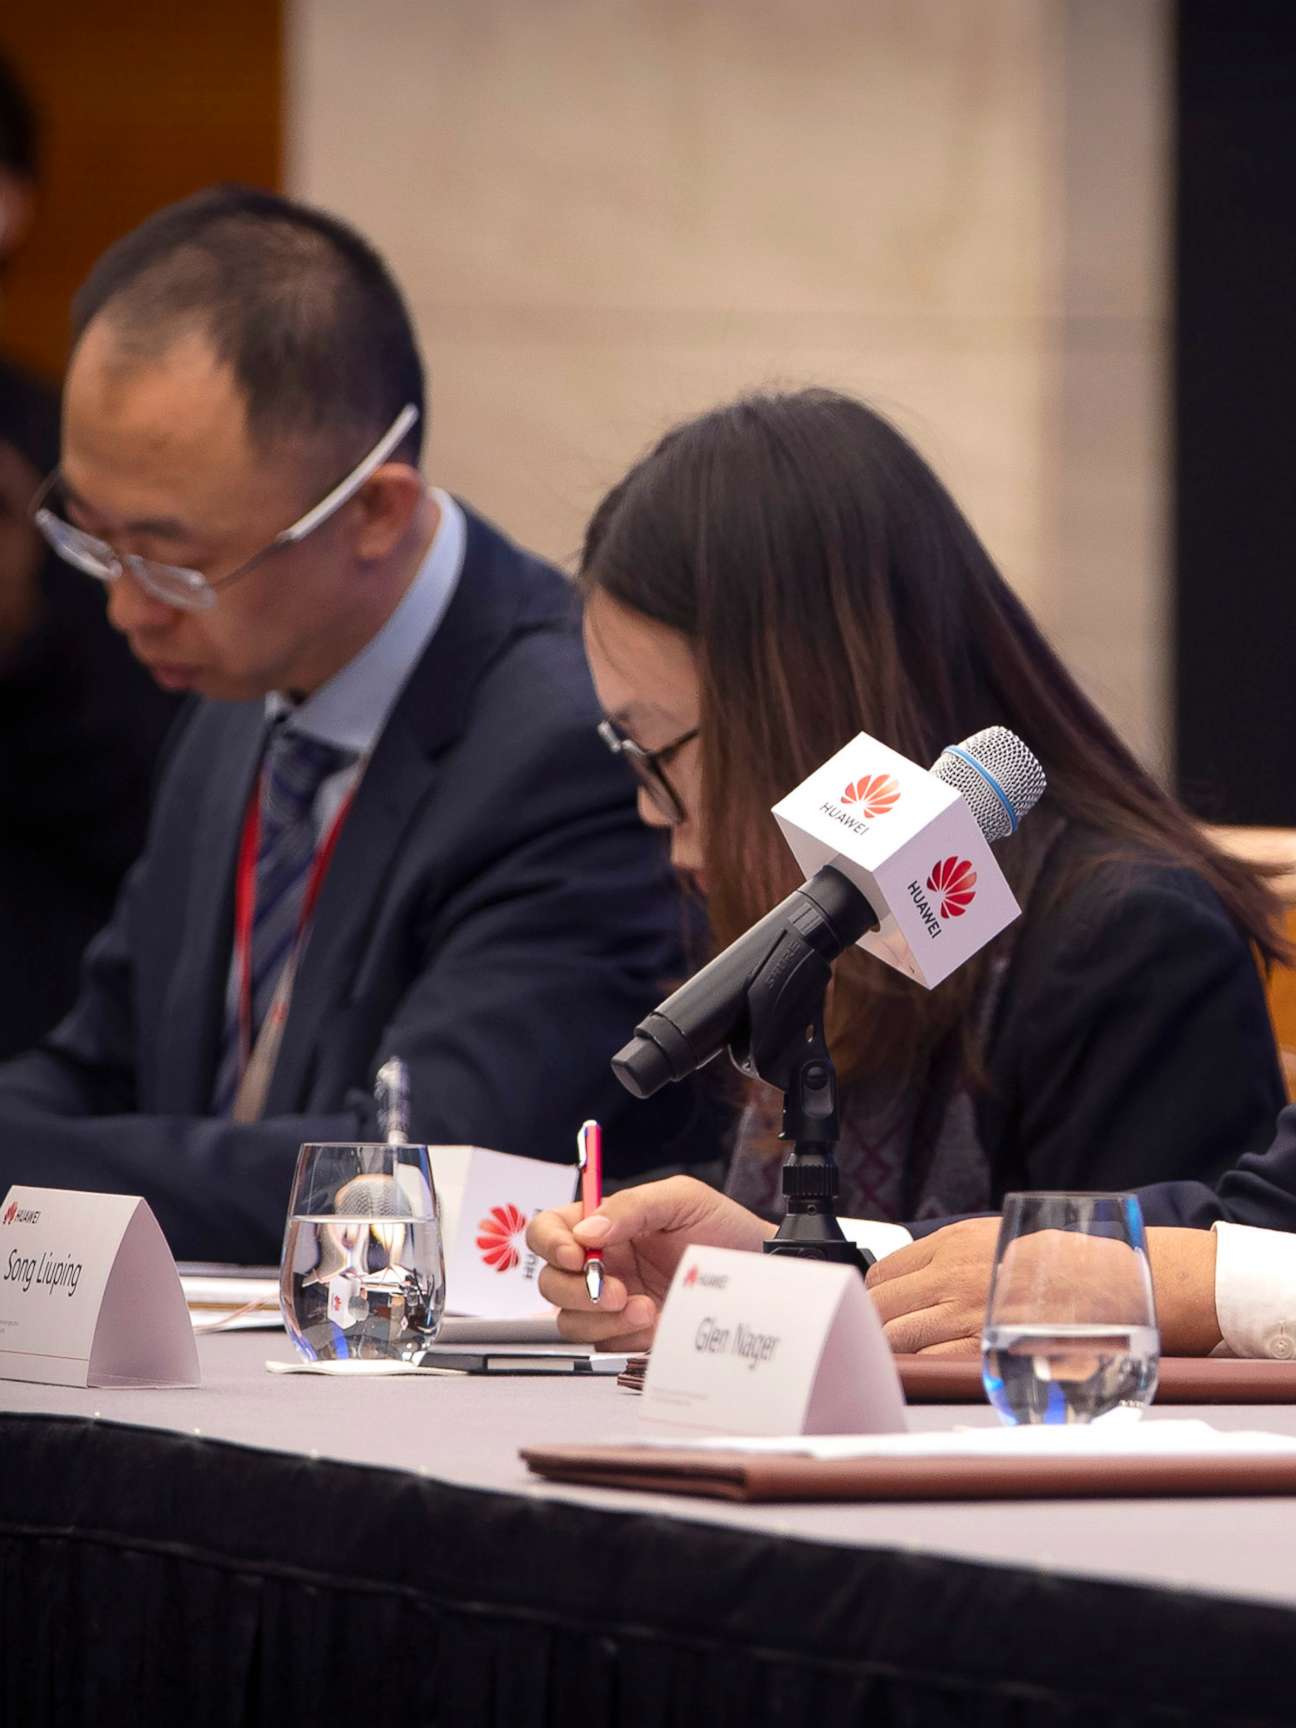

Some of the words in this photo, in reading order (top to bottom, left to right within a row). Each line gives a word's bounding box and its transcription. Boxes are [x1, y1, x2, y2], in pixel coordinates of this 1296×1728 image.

[819, 802, 870, 836] HUAWEI
[907, 880, 942, 939] HUAWEI
[15, 1210, 41, 1224] HUAWEI
[4, 1249, 37, 1292] Song
[36, 1252, 82, 1297] Liuping
[695, 1316, 730, 1354] Glen
[732, 1322, 781, 1371] Nager
